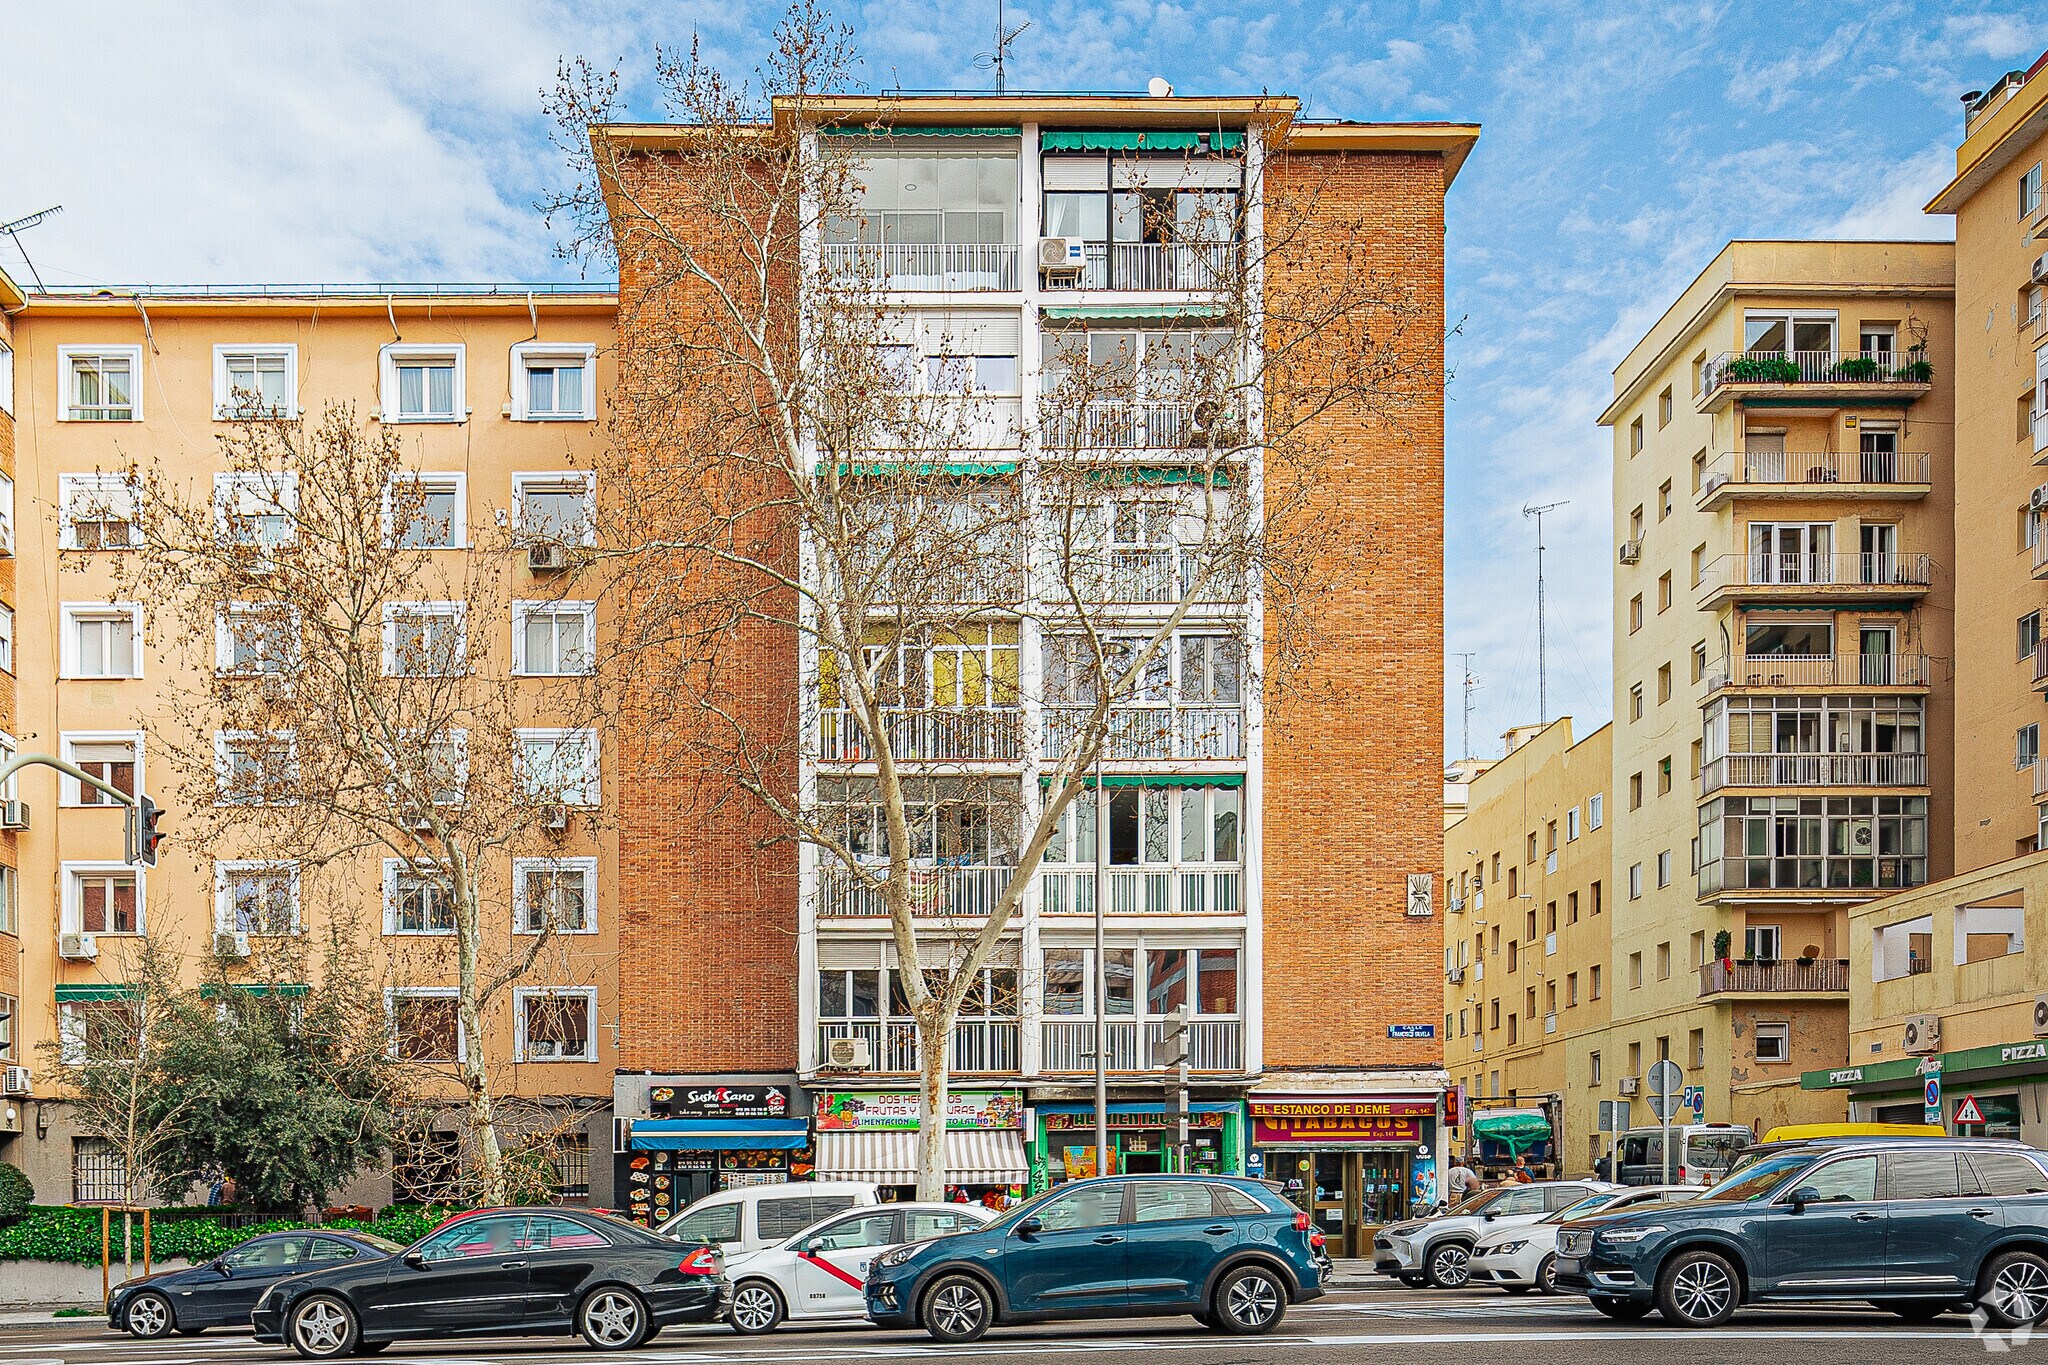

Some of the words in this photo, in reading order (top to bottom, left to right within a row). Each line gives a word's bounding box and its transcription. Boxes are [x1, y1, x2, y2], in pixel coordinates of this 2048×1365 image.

[2001, 1044, 2047, 1062] PIZZA
[1829, 1069, 1863, 1084] PIZZA
[688, 1088, 720, 1104] Sushi
[722, 1090, 755, 1104] Sano
[878, 1095, 901, 1104] DOS
[903, 1095, 962, 1104] HEOS
[1685, 1089, 1691, 1106] P
[865, 1106, 907, 1115] FRUTAS
[910, 1106, 917, 1115] Y
[1254, 1105, 1269, 1115] EL
[1273, 1104, 1330, 1115] ESTANCO
[1334, 1104, 1351, 1114] DE
[1355, 1104, 1391, 1114] DEME
